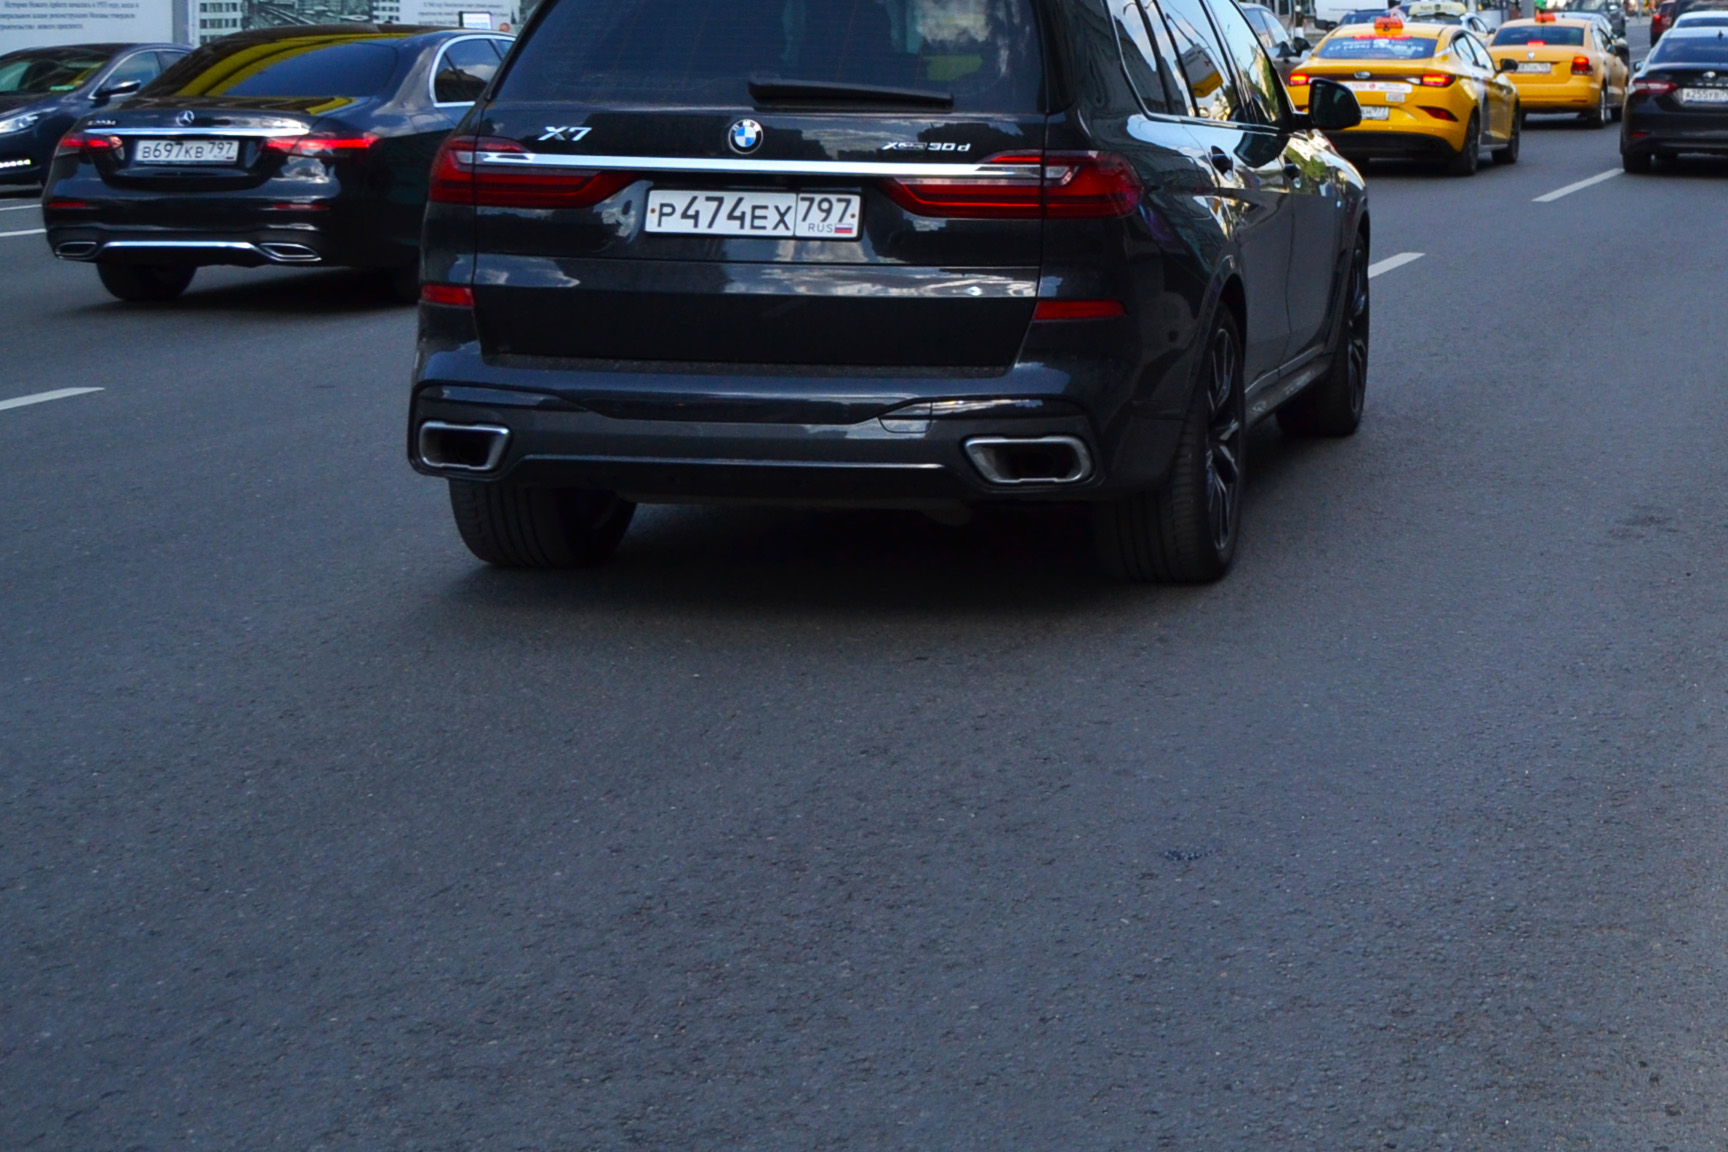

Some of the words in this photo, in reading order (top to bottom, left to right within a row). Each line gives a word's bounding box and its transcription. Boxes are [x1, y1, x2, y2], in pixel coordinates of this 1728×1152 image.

[537, 126, 592, 142] X7
[208, 141, 234, 154] 797
[799, 196, 852, 223] 797
[807, 223, 833, 233] RUS
